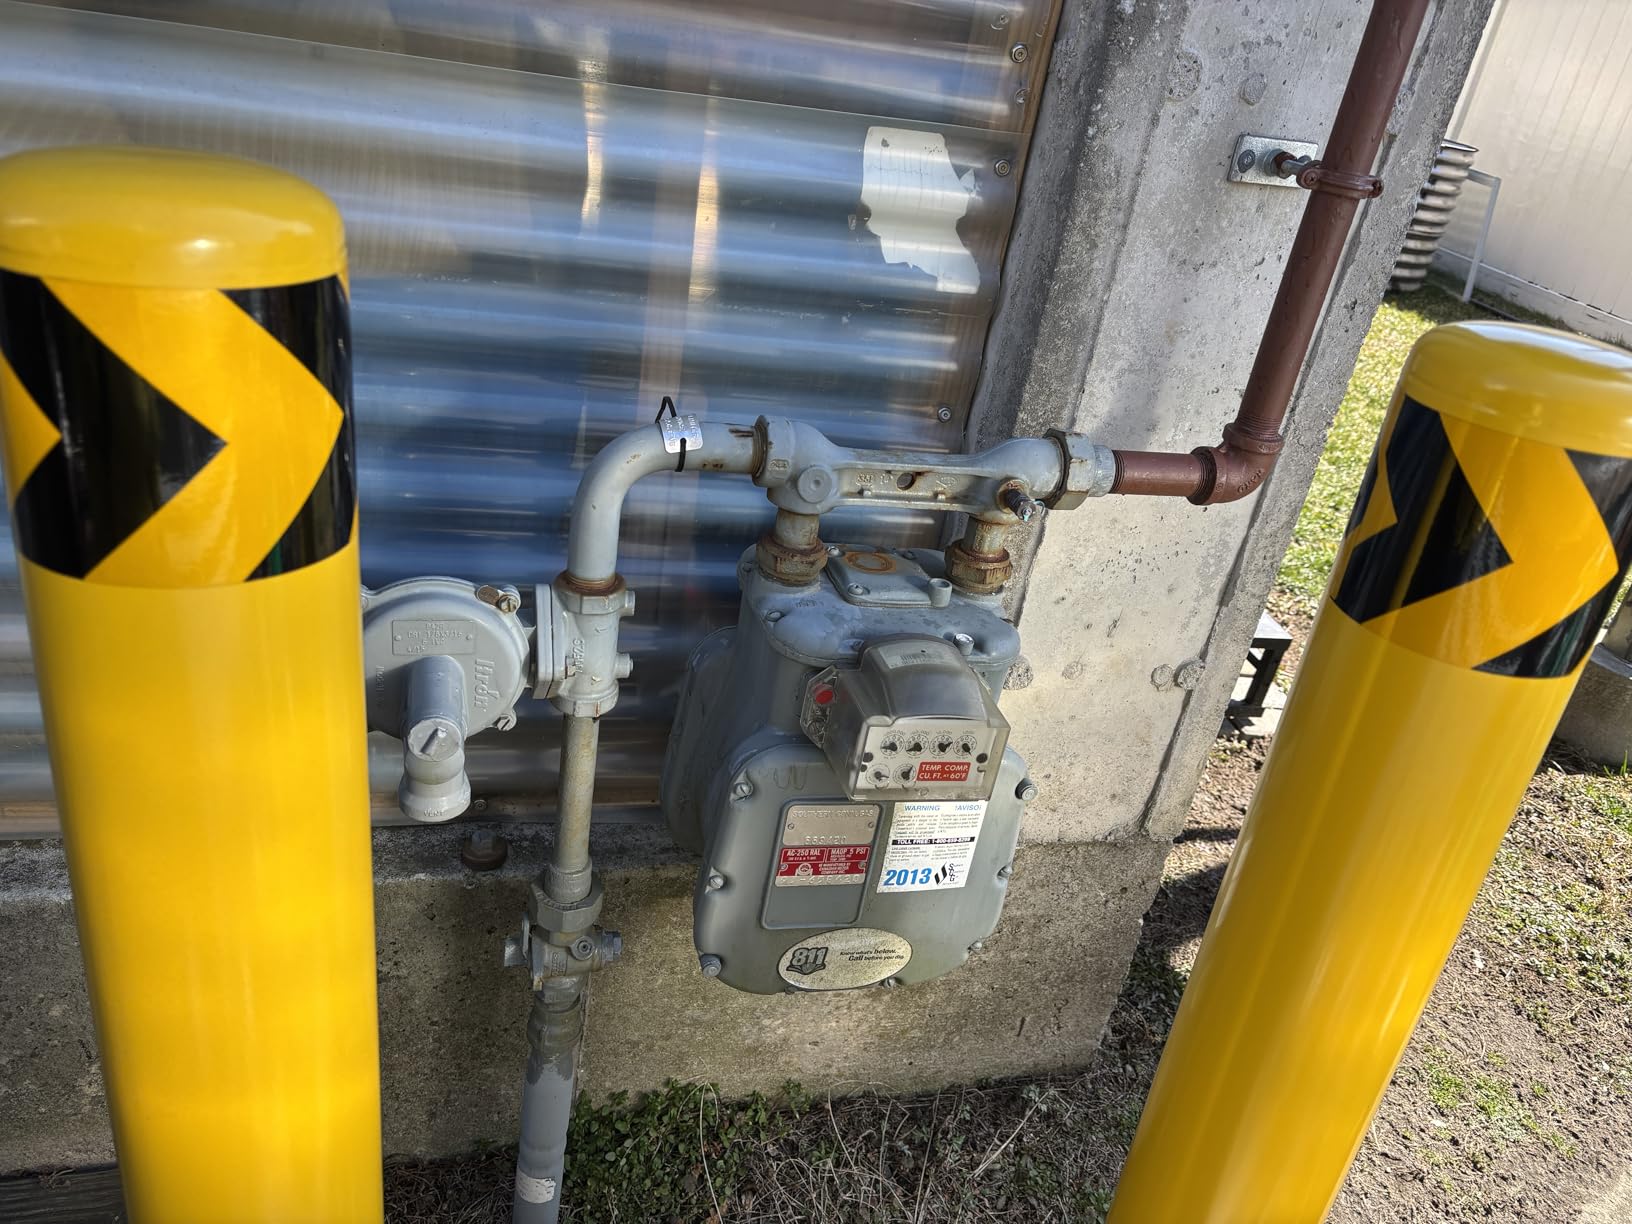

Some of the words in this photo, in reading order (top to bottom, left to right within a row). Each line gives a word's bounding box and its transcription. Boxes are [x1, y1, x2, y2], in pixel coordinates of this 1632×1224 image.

[474, 658, 501, 709] Itron
[424, 808, 445, 817] VENT
[883, 868, 932, 886] 2013
[792, 947, 828, 966] 811
